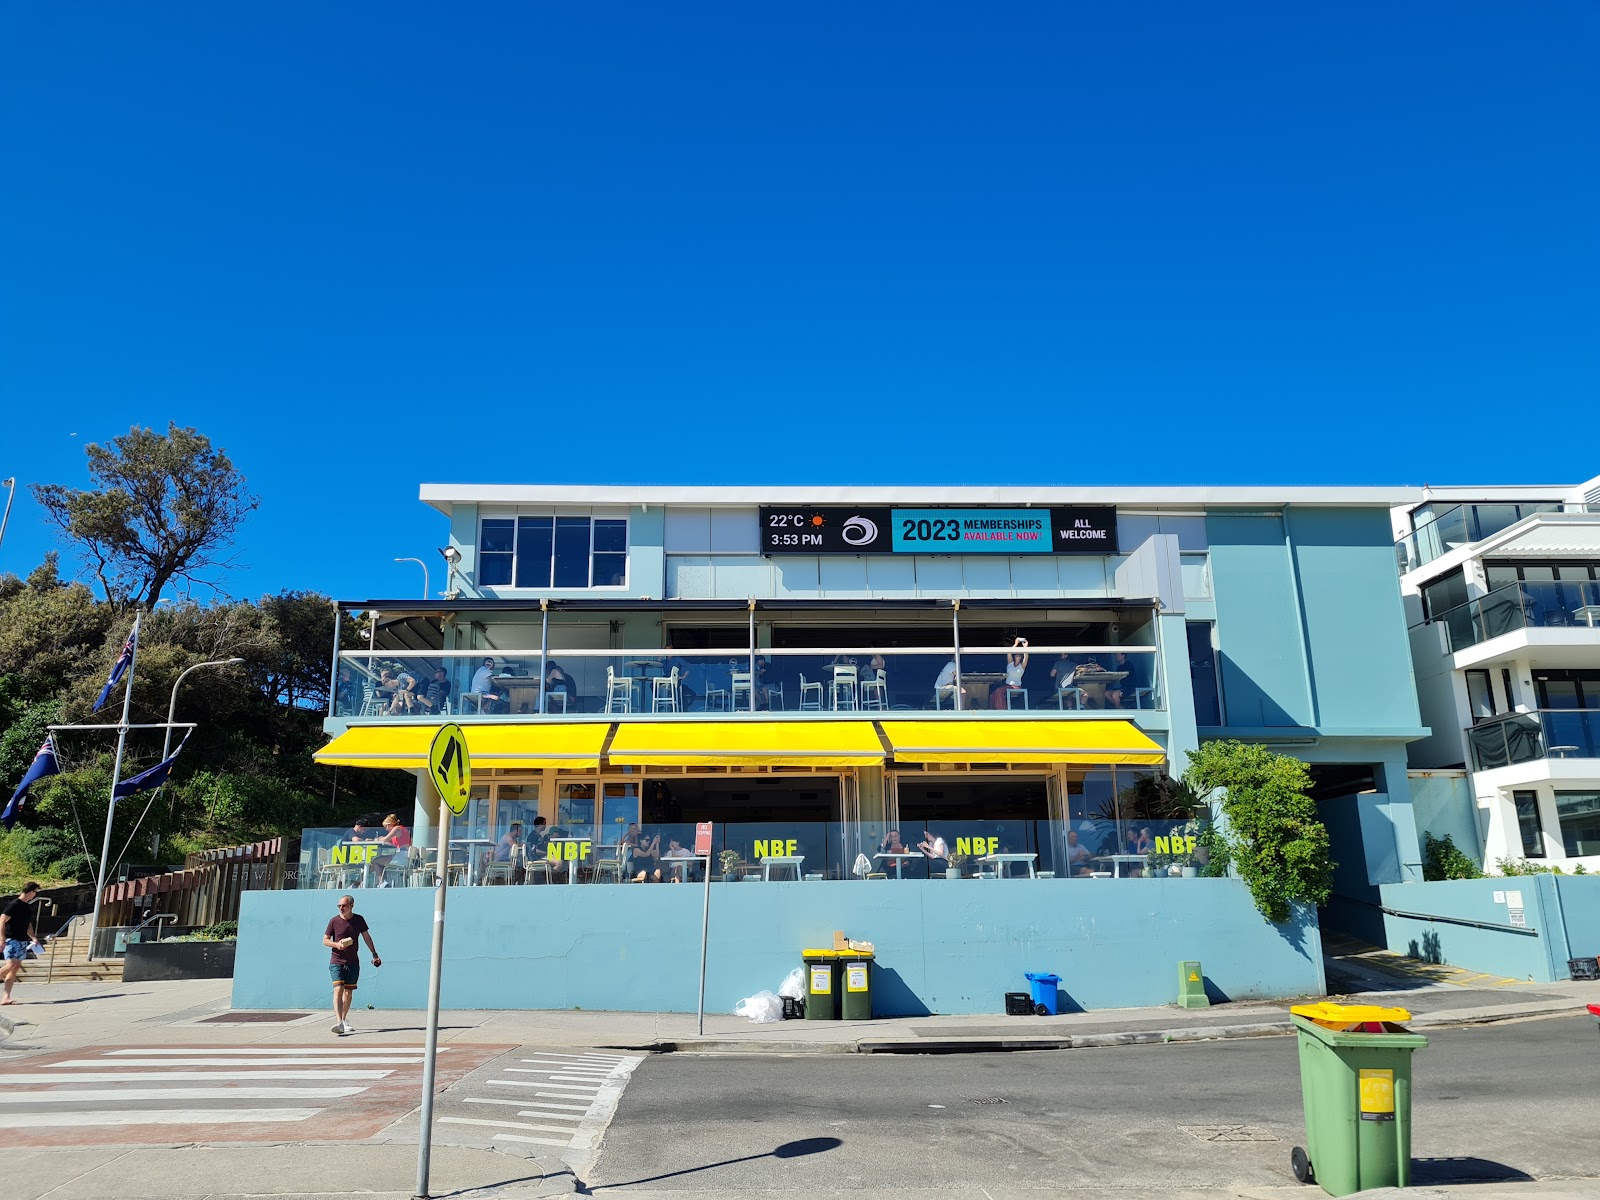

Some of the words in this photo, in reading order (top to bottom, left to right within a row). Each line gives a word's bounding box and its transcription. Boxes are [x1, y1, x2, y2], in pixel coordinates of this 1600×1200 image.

[769, 514, 804, 527] 22°C
[963, 519, 1042, 530] MEMBERSHIPS
[1074, 519, 1092, 528] ALL
[902, 519, 960, 541] 2023
[963, 531, 1013, 541] AVAILABLE
[1060, 529, 1107, 539] WELCOME
[771, 534, 799, 545] 3:53
[801, 534, 823, 545] PM
[547, 841, 592, 861] NBF
[754, 839, 798, 858] NBF
[956, 837, 999, 856] NBF
[1154, 835, 1197, 854] NBF
[331, 845, 379, 865] NBF
